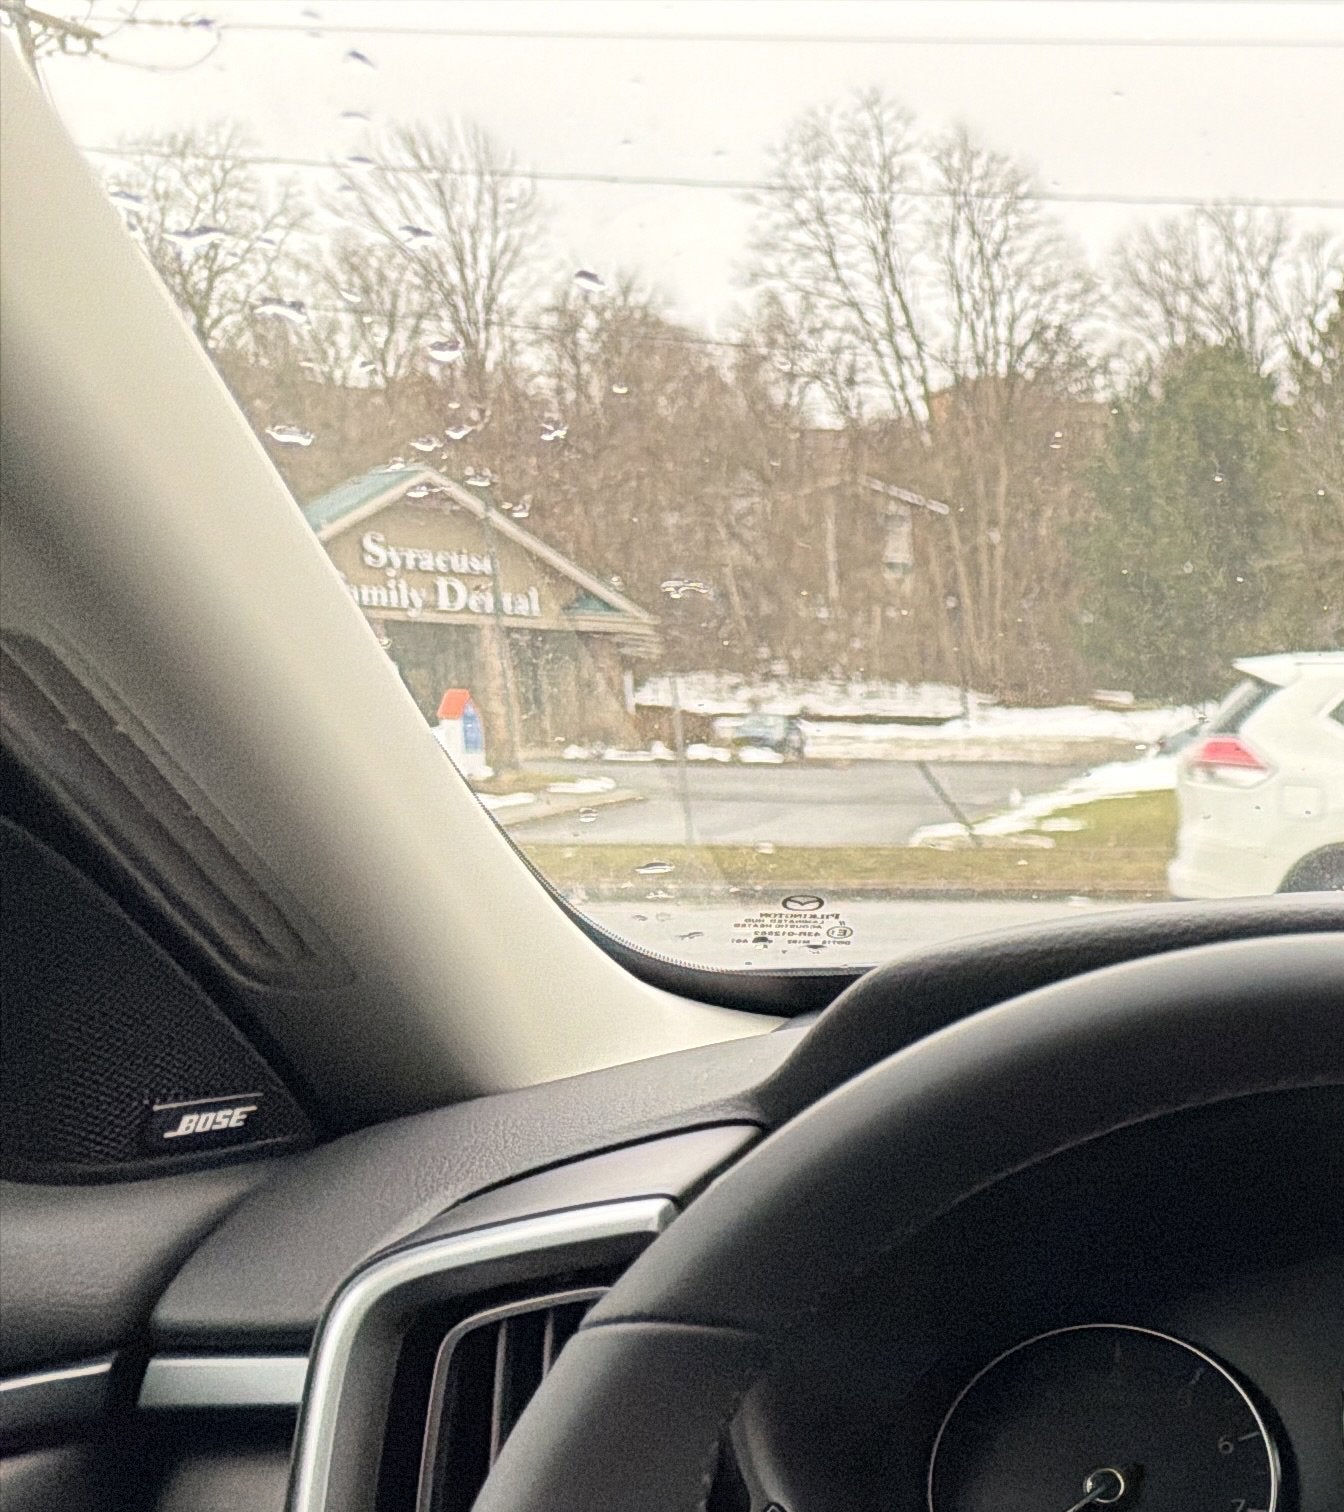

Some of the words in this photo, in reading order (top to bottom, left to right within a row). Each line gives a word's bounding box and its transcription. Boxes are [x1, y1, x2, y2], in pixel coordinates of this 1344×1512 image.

[349, 578, 428, 618] amily
[163, 1105, 258, 1139] BOSE
[1218, 1434, 1235, 1454] 6
